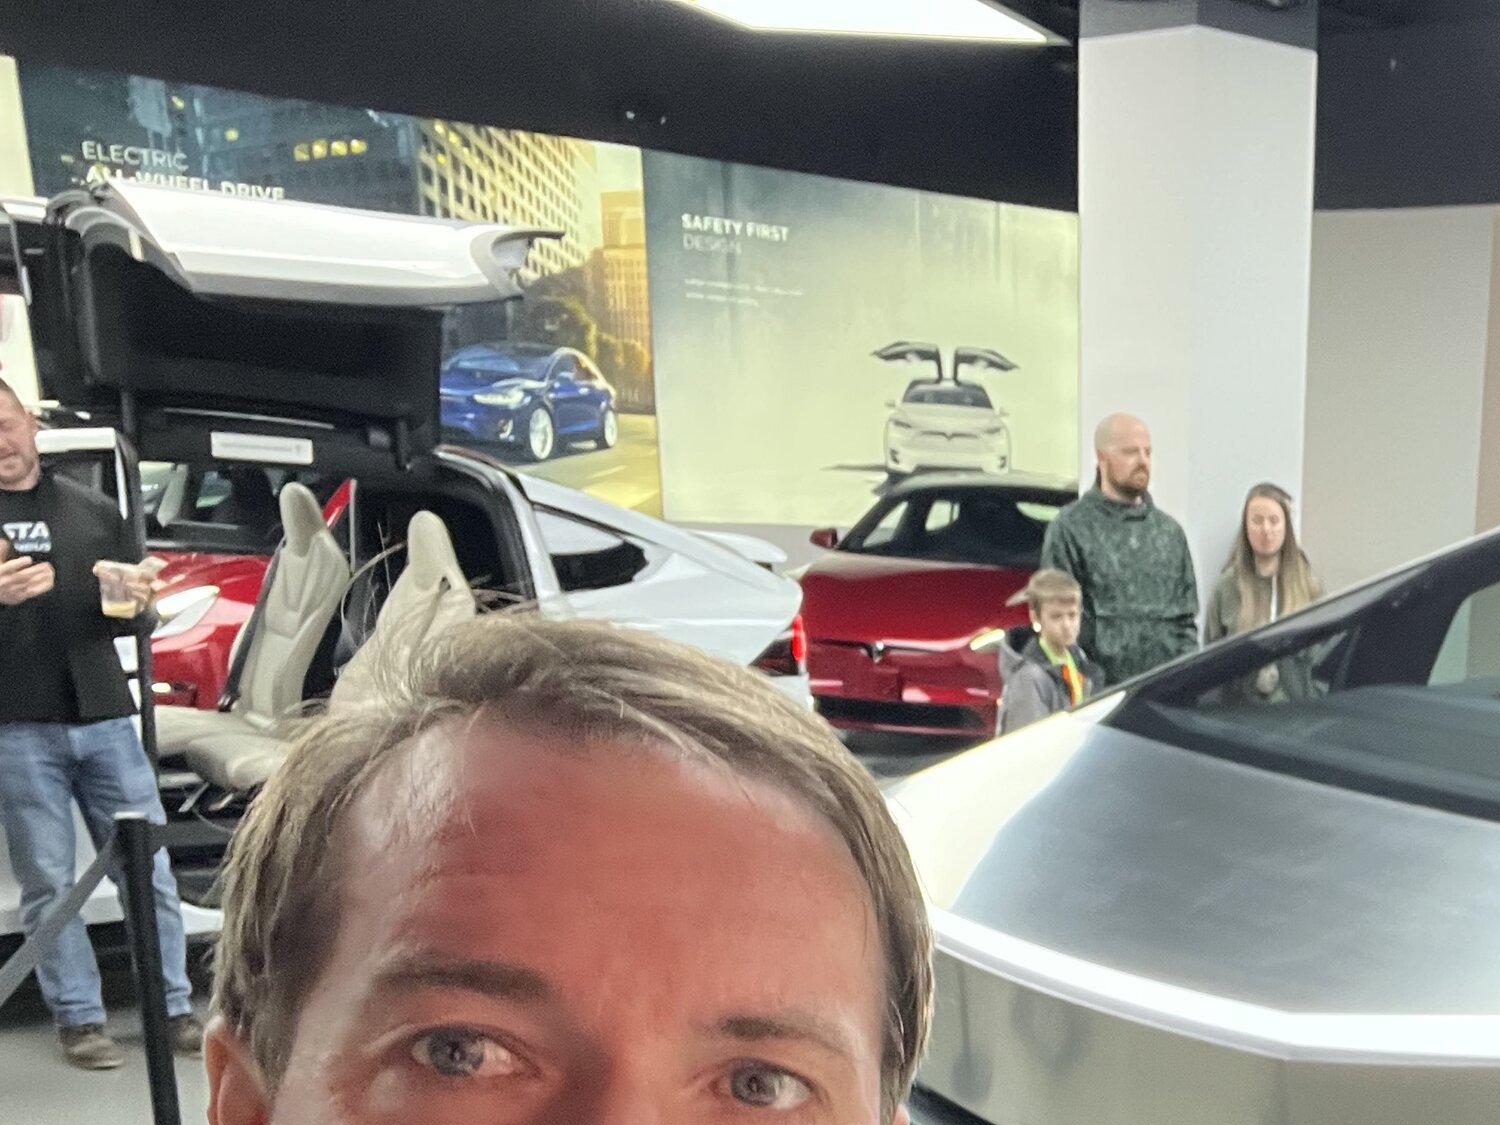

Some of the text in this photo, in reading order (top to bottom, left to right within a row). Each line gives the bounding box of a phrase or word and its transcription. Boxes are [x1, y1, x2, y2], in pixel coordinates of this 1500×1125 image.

[81, 139, 190, 171] ELECTRIC
[219, 180, 286, 201] DRIVE
[681, 212, 789, 242] SAFETY FIRST
[682, 232, 742, 255] DESIGN
